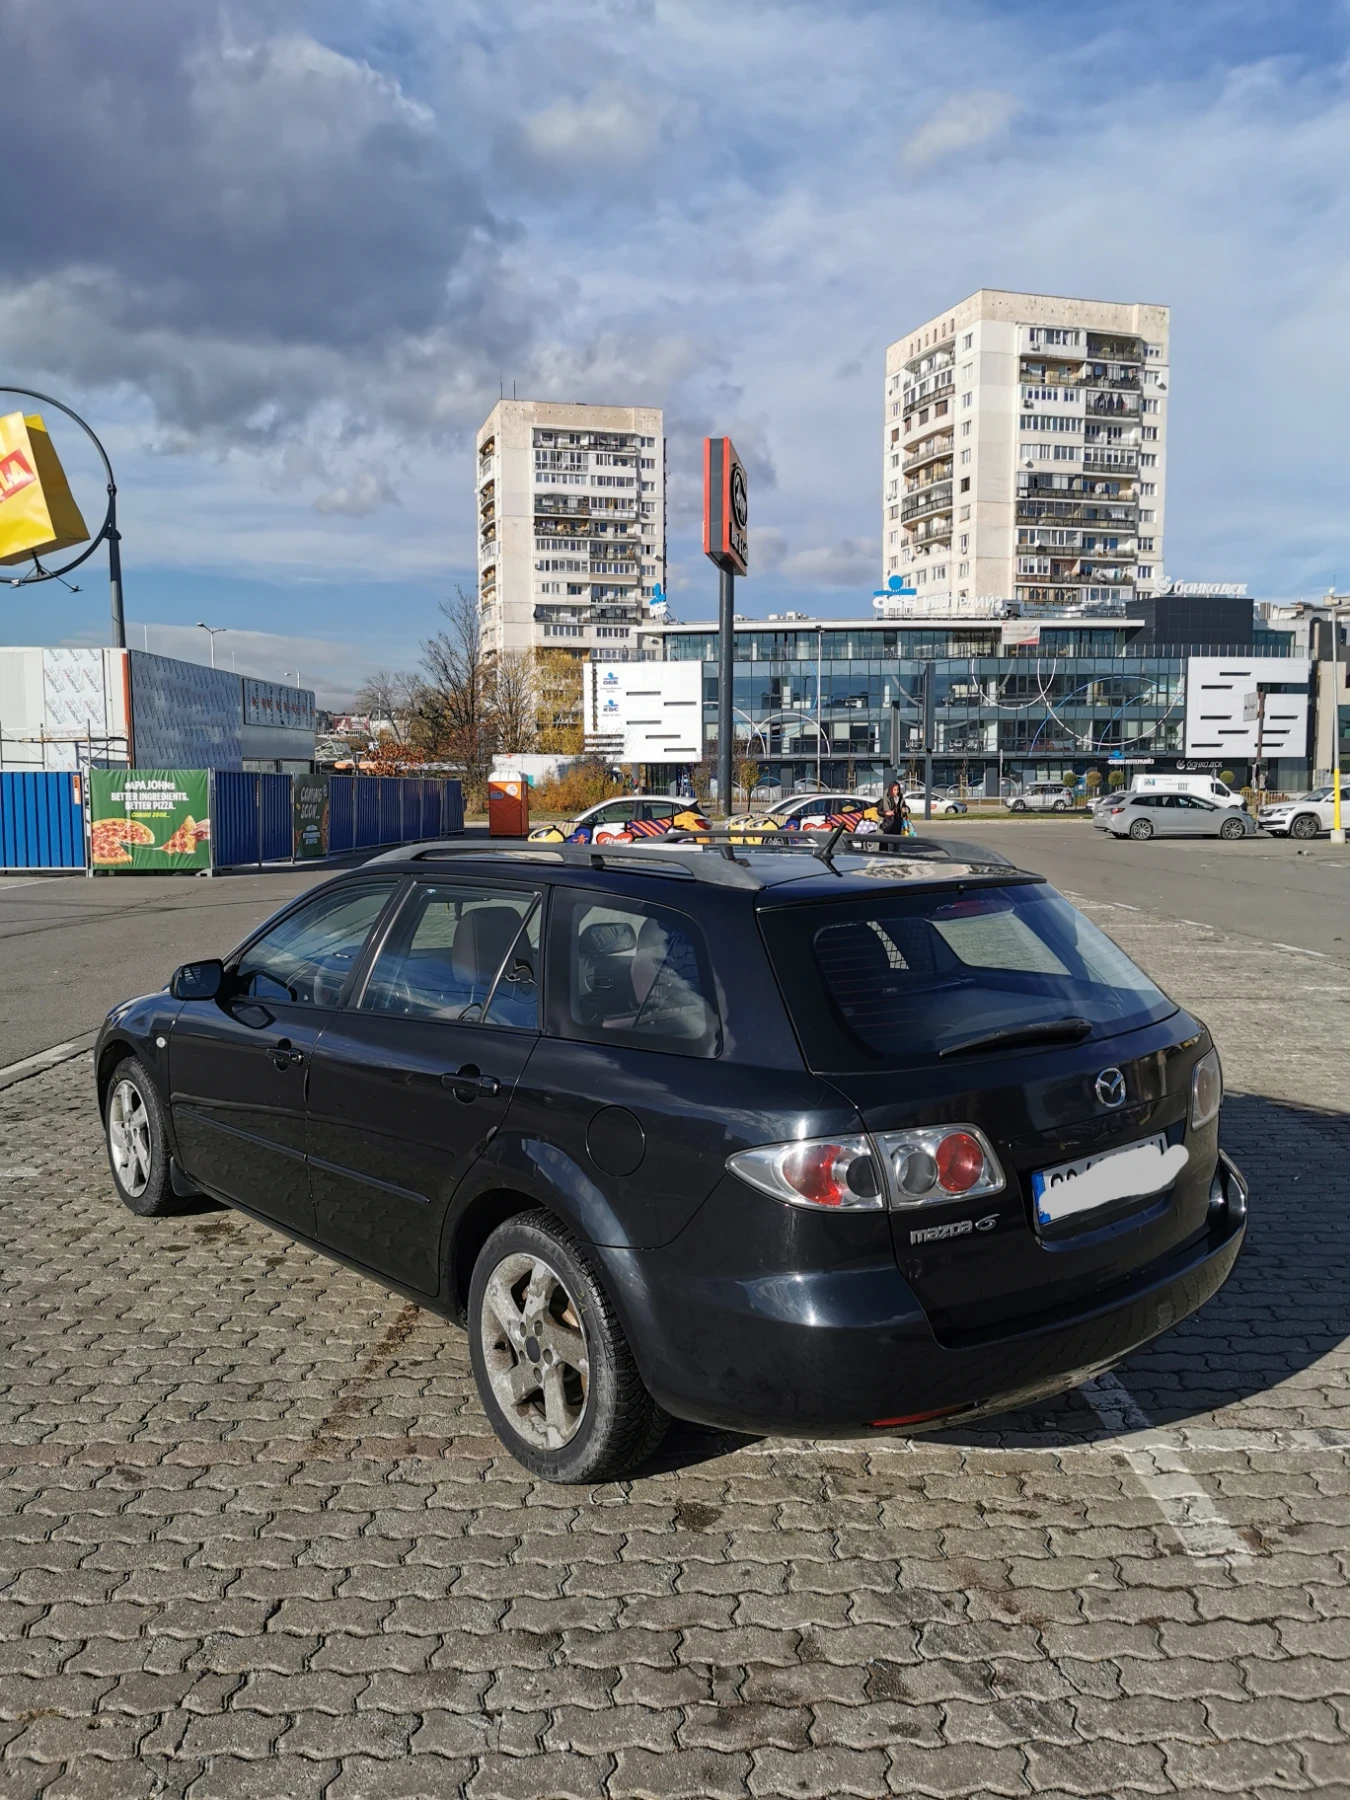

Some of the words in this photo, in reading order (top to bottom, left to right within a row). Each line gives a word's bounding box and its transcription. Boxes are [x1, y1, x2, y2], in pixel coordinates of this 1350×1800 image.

[124, 781, 146, 790] PAPA
[147, 780, 176, 790] JOHNS
[111, 792, 138, 801] BETTER
[139, 792, 189, 801] INGREDIENTS.
[125, 801, 152, 810] BETTER
[152, 801, 176, 810] PIZZA.
[910, 1220, 973, 1245] mazda
[975, 1213, 1000, 1231] 6
